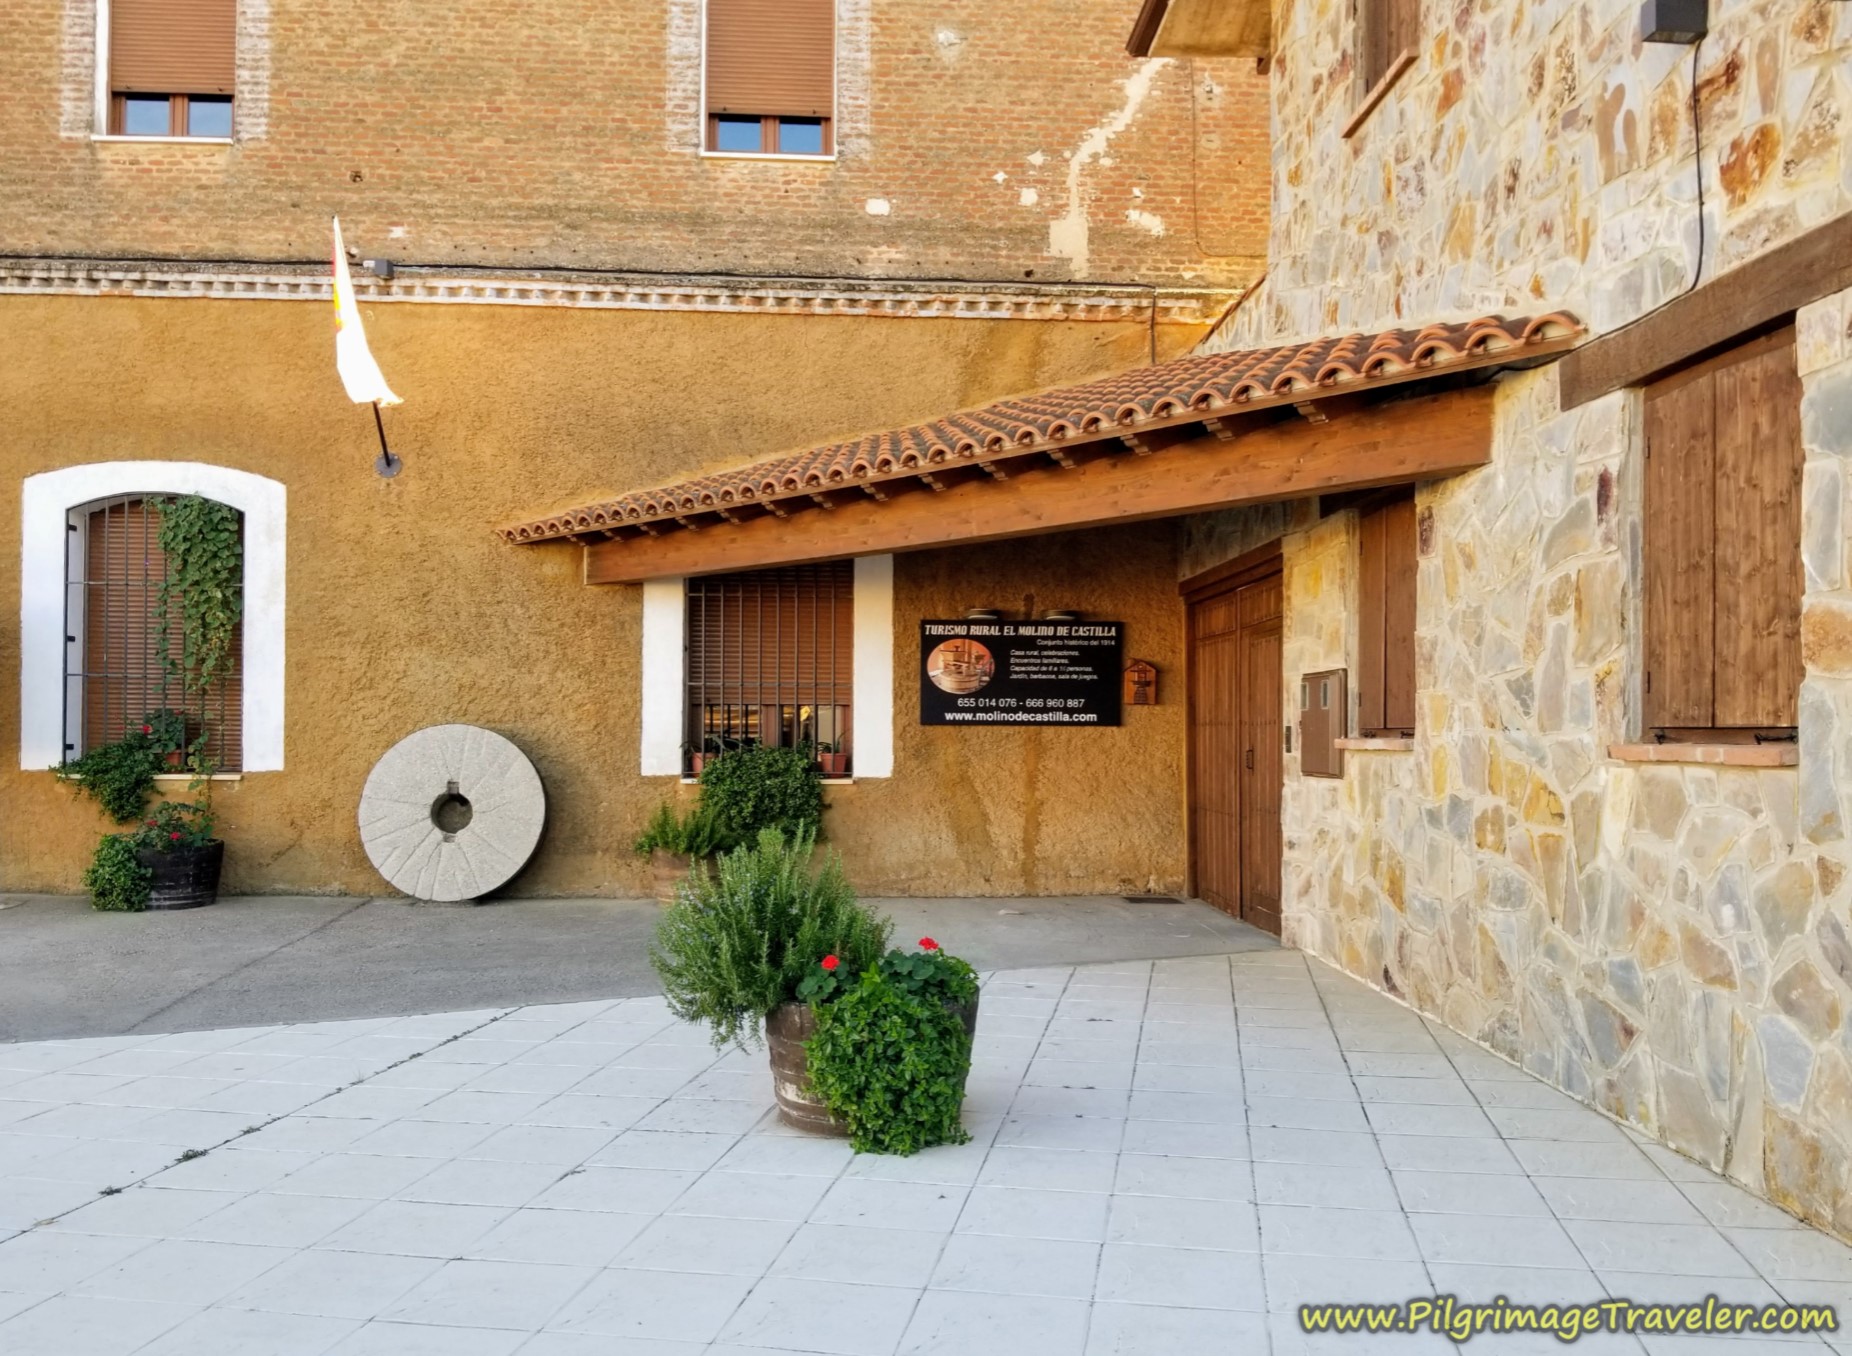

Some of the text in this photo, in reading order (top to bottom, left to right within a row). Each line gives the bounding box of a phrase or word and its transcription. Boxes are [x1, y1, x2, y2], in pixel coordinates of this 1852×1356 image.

[925, 625, 1116, 637] TURISMO RURAL EL MOLINO DE CASTILLA
[957, 698, 976, 707] 655
[978, 698, 996, 707] 014
[999, 698, 1017, 707] 076
[1025, 698, 1044, 708] 666
[1046, 698, 1065, 708] 960
[1066, 698, 1085, 708] 887
[944, 711, 1098, 722] www.molinodecastilla.com
